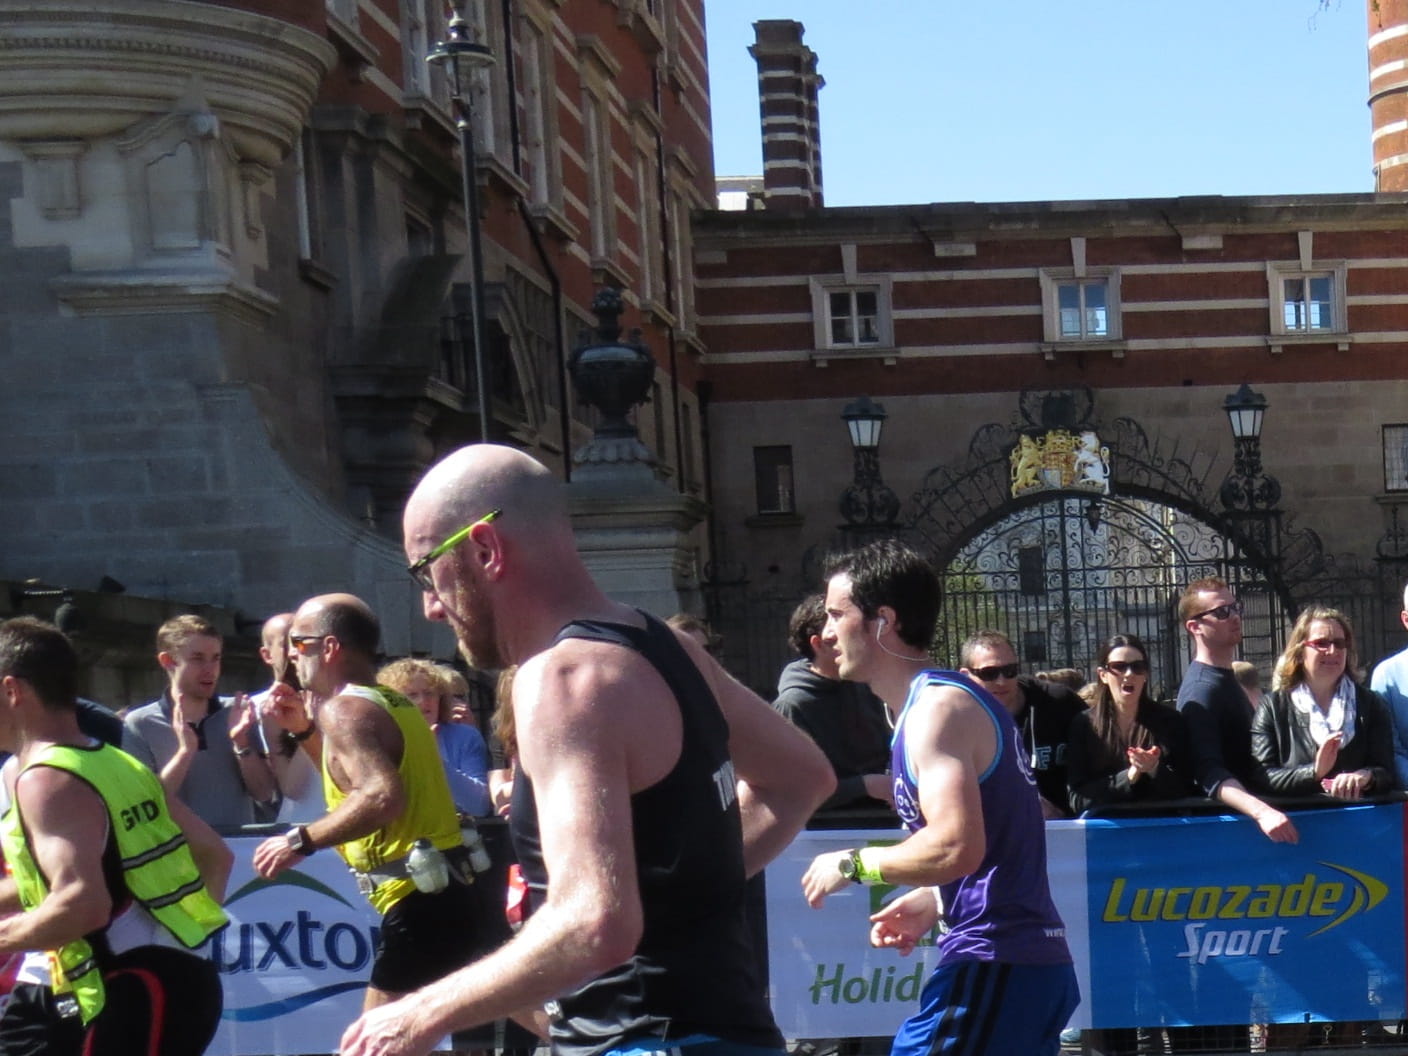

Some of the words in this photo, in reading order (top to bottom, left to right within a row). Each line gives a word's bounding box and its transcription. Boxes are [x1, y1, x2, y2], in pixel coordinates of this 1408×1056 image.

[1103, 873, 1344, 922] Lucozade
[209, 910, 383, 975] uxto
[1176, 923, 1289, 965] Sport
[808, 962, 924, 1005] Holid
